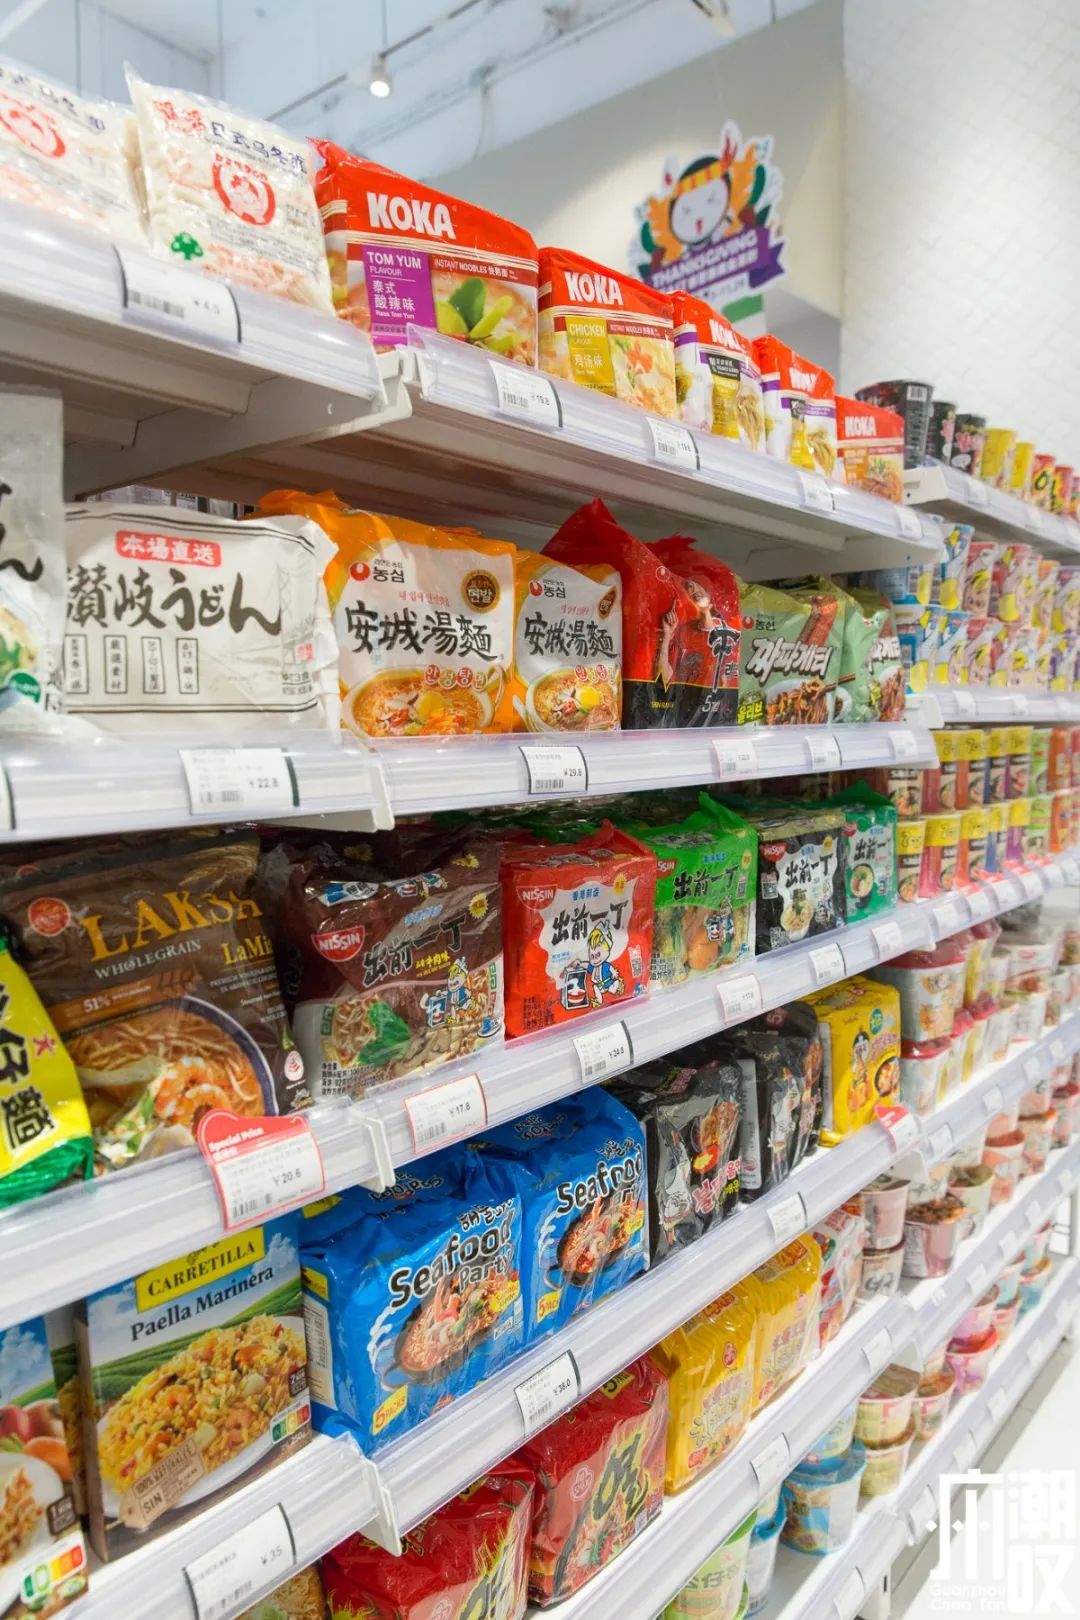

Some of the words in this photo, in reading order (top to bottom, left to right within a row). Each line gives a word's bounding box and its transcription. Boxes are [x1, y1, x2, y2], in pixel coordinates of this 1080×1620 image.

[366, 192, 456, 240] KOKA
[367, 252, 393, 265] TOM
[399, 254, 421, 269] YUM
[370, 266, 402, 276] FLAVOUR
[434, 259, 459, 269] INSTANT
[459, 263, 488, 274] NOODLES
[373, 280, 396, 295] 泰式
[374, 294, 415, 311] 酸辣味
[564, 272, 624, 305] KOKA
[569, 323, 606, 337] CHICKEN
[844, 415, 877, 437] KOKA
[122, 534, 216, 565] 本場直送
[372, 566, 405, 583] 농심
[745, 637, 833, 685] 짜파게티
[673, 864, 740, 900] 出前一丁
[785, 853, 833, 888] 出前一丁
[522, 888, 554, 902] NISSIN
[79, 890, 263, 961] LAKSA
[551, 900, 629, 946] 出前一丁
[318, 933, 361, 951] NISSIN
[362, 914, 467, 988] 出前一丁
[94, 939, 201, 980] WHOLEGRAIN
[148, 1241, 256, 1297] CARRETILLA
[388, 1208, 516, 1308] Seafood
[459, 1242, 515, 1293] Party
[130, 1304, 191, 1342] Paella
[195, 1267, 274, 1315] Marinera
[142, 1490, 163, 1515] SIN
